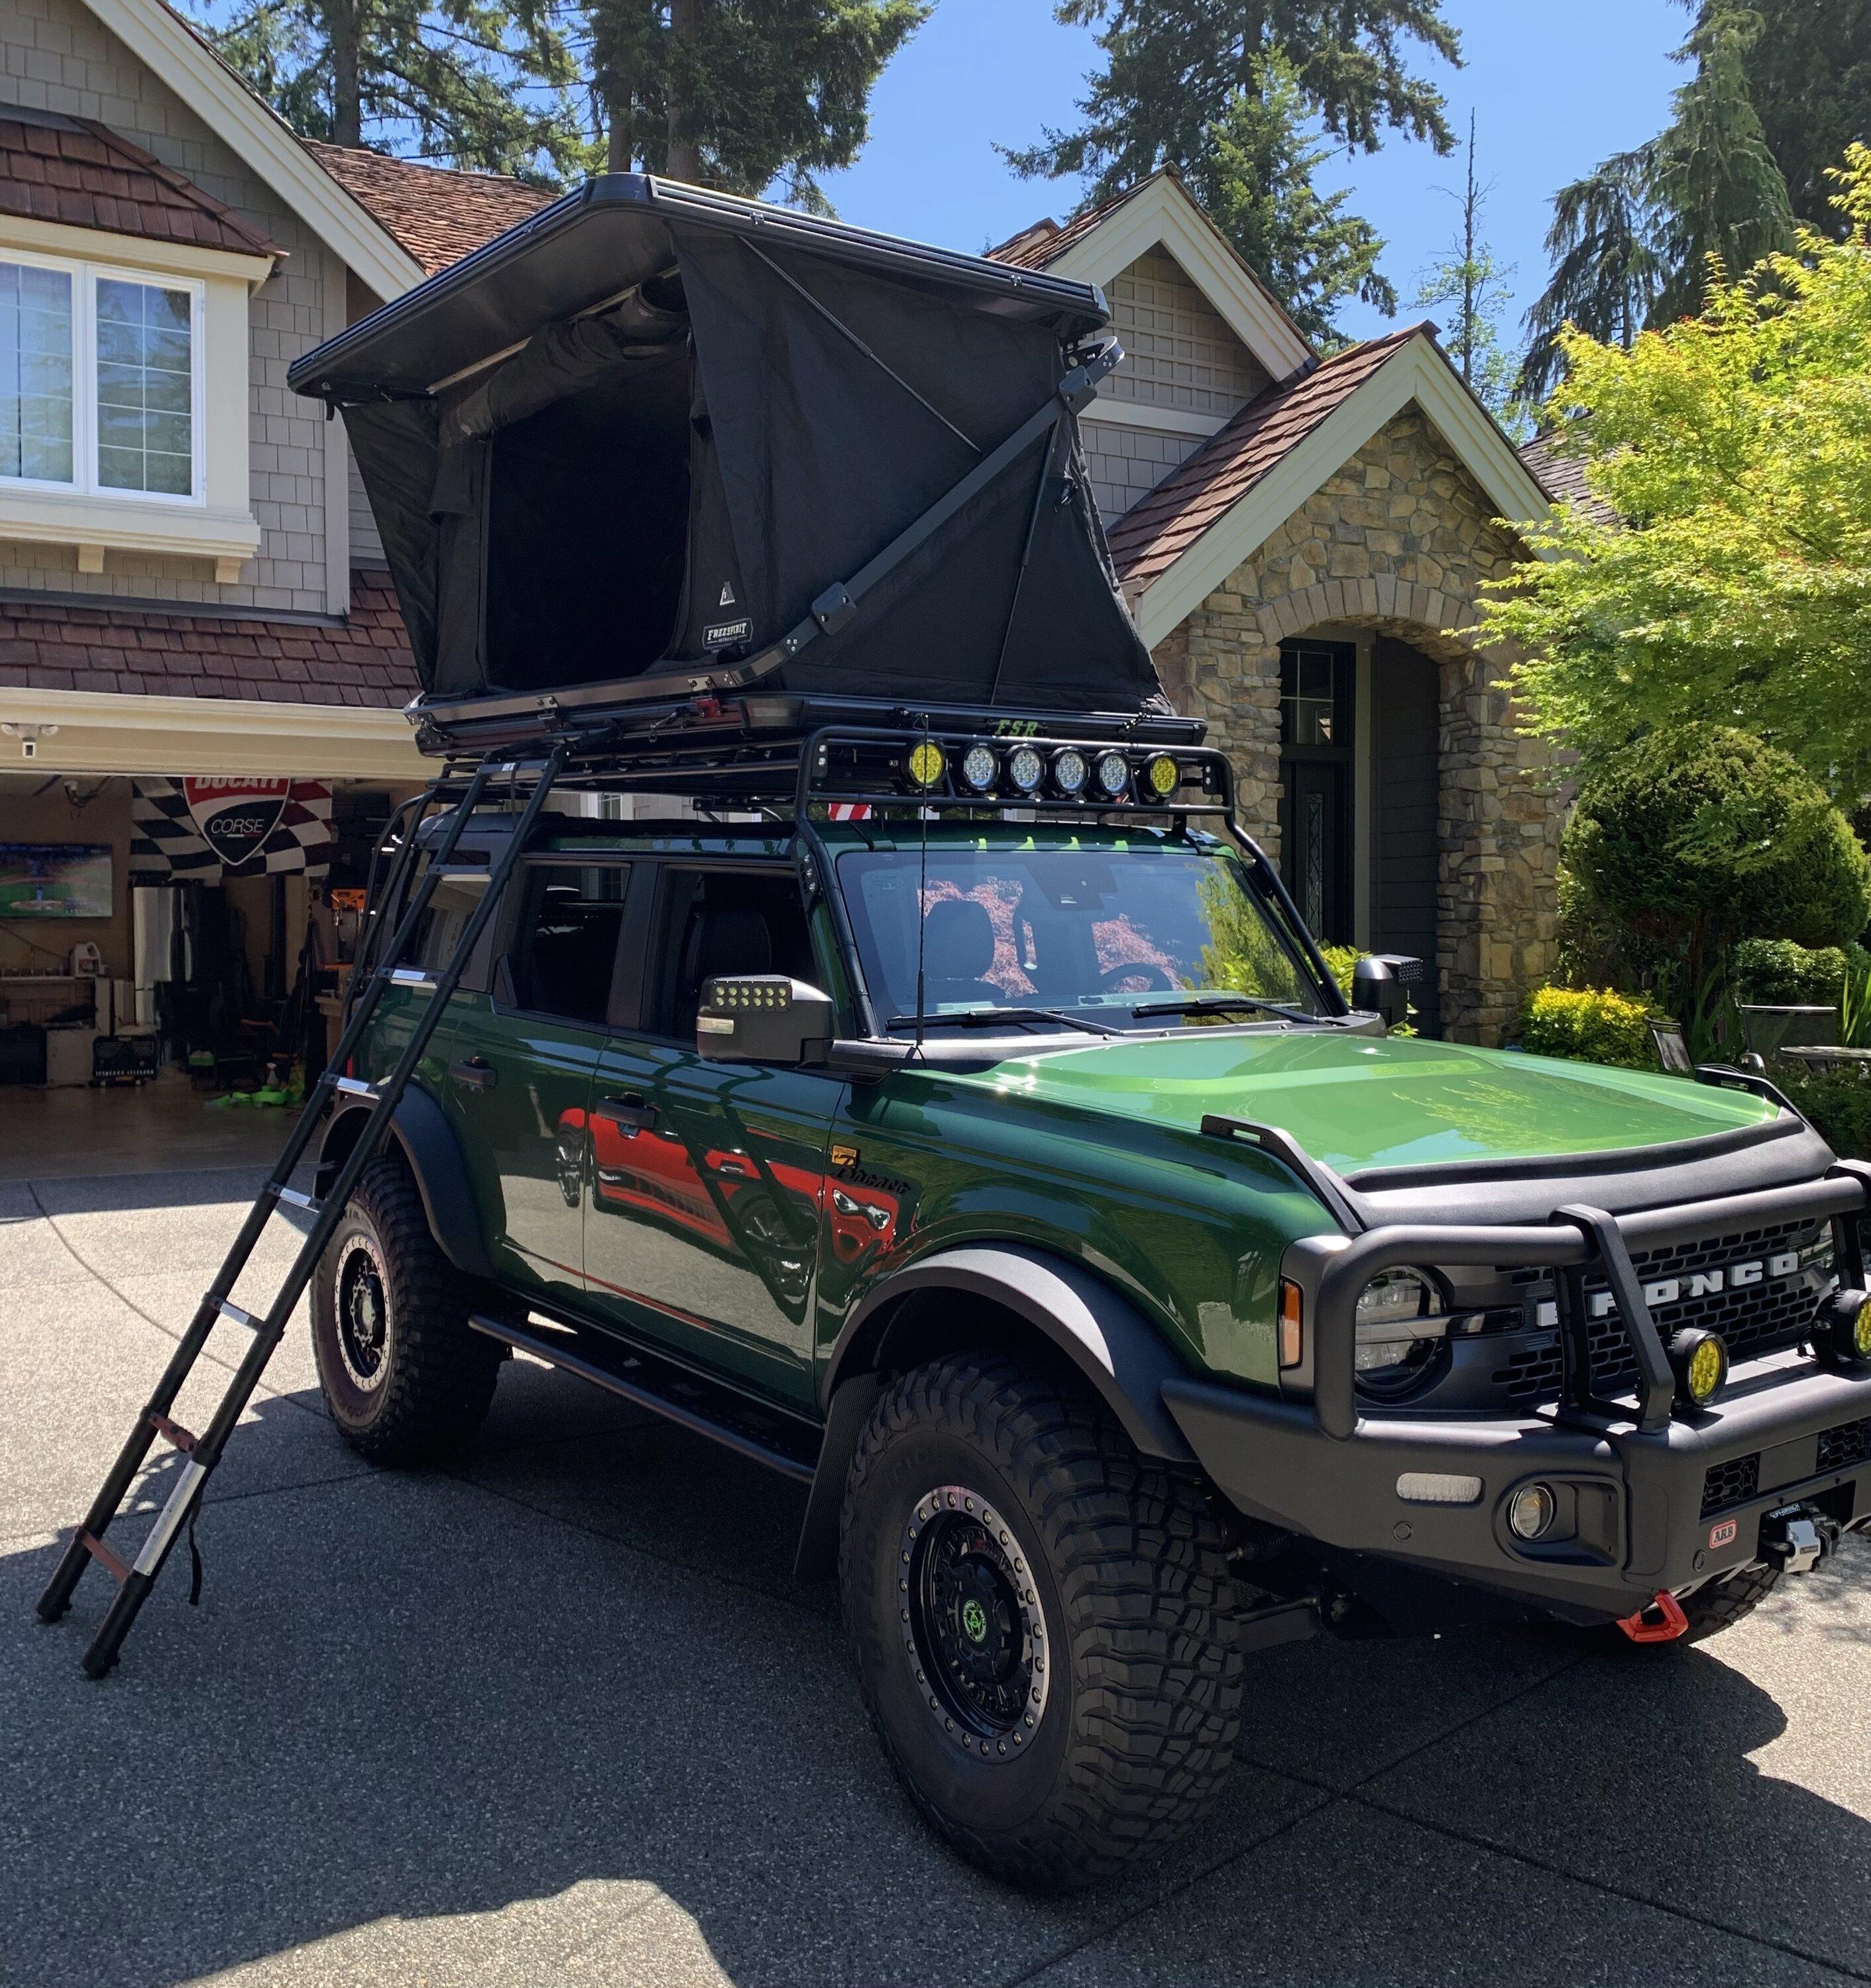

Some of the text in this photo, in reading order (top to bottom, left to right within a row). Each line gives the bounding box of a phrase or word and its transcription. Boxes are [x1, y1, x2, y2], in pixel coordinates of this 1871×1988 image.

[994, 719, 1039, 736] FSR
[211, 818, 265, 834] CORSE
[1713, 1525, 1734, 1543] ARB
